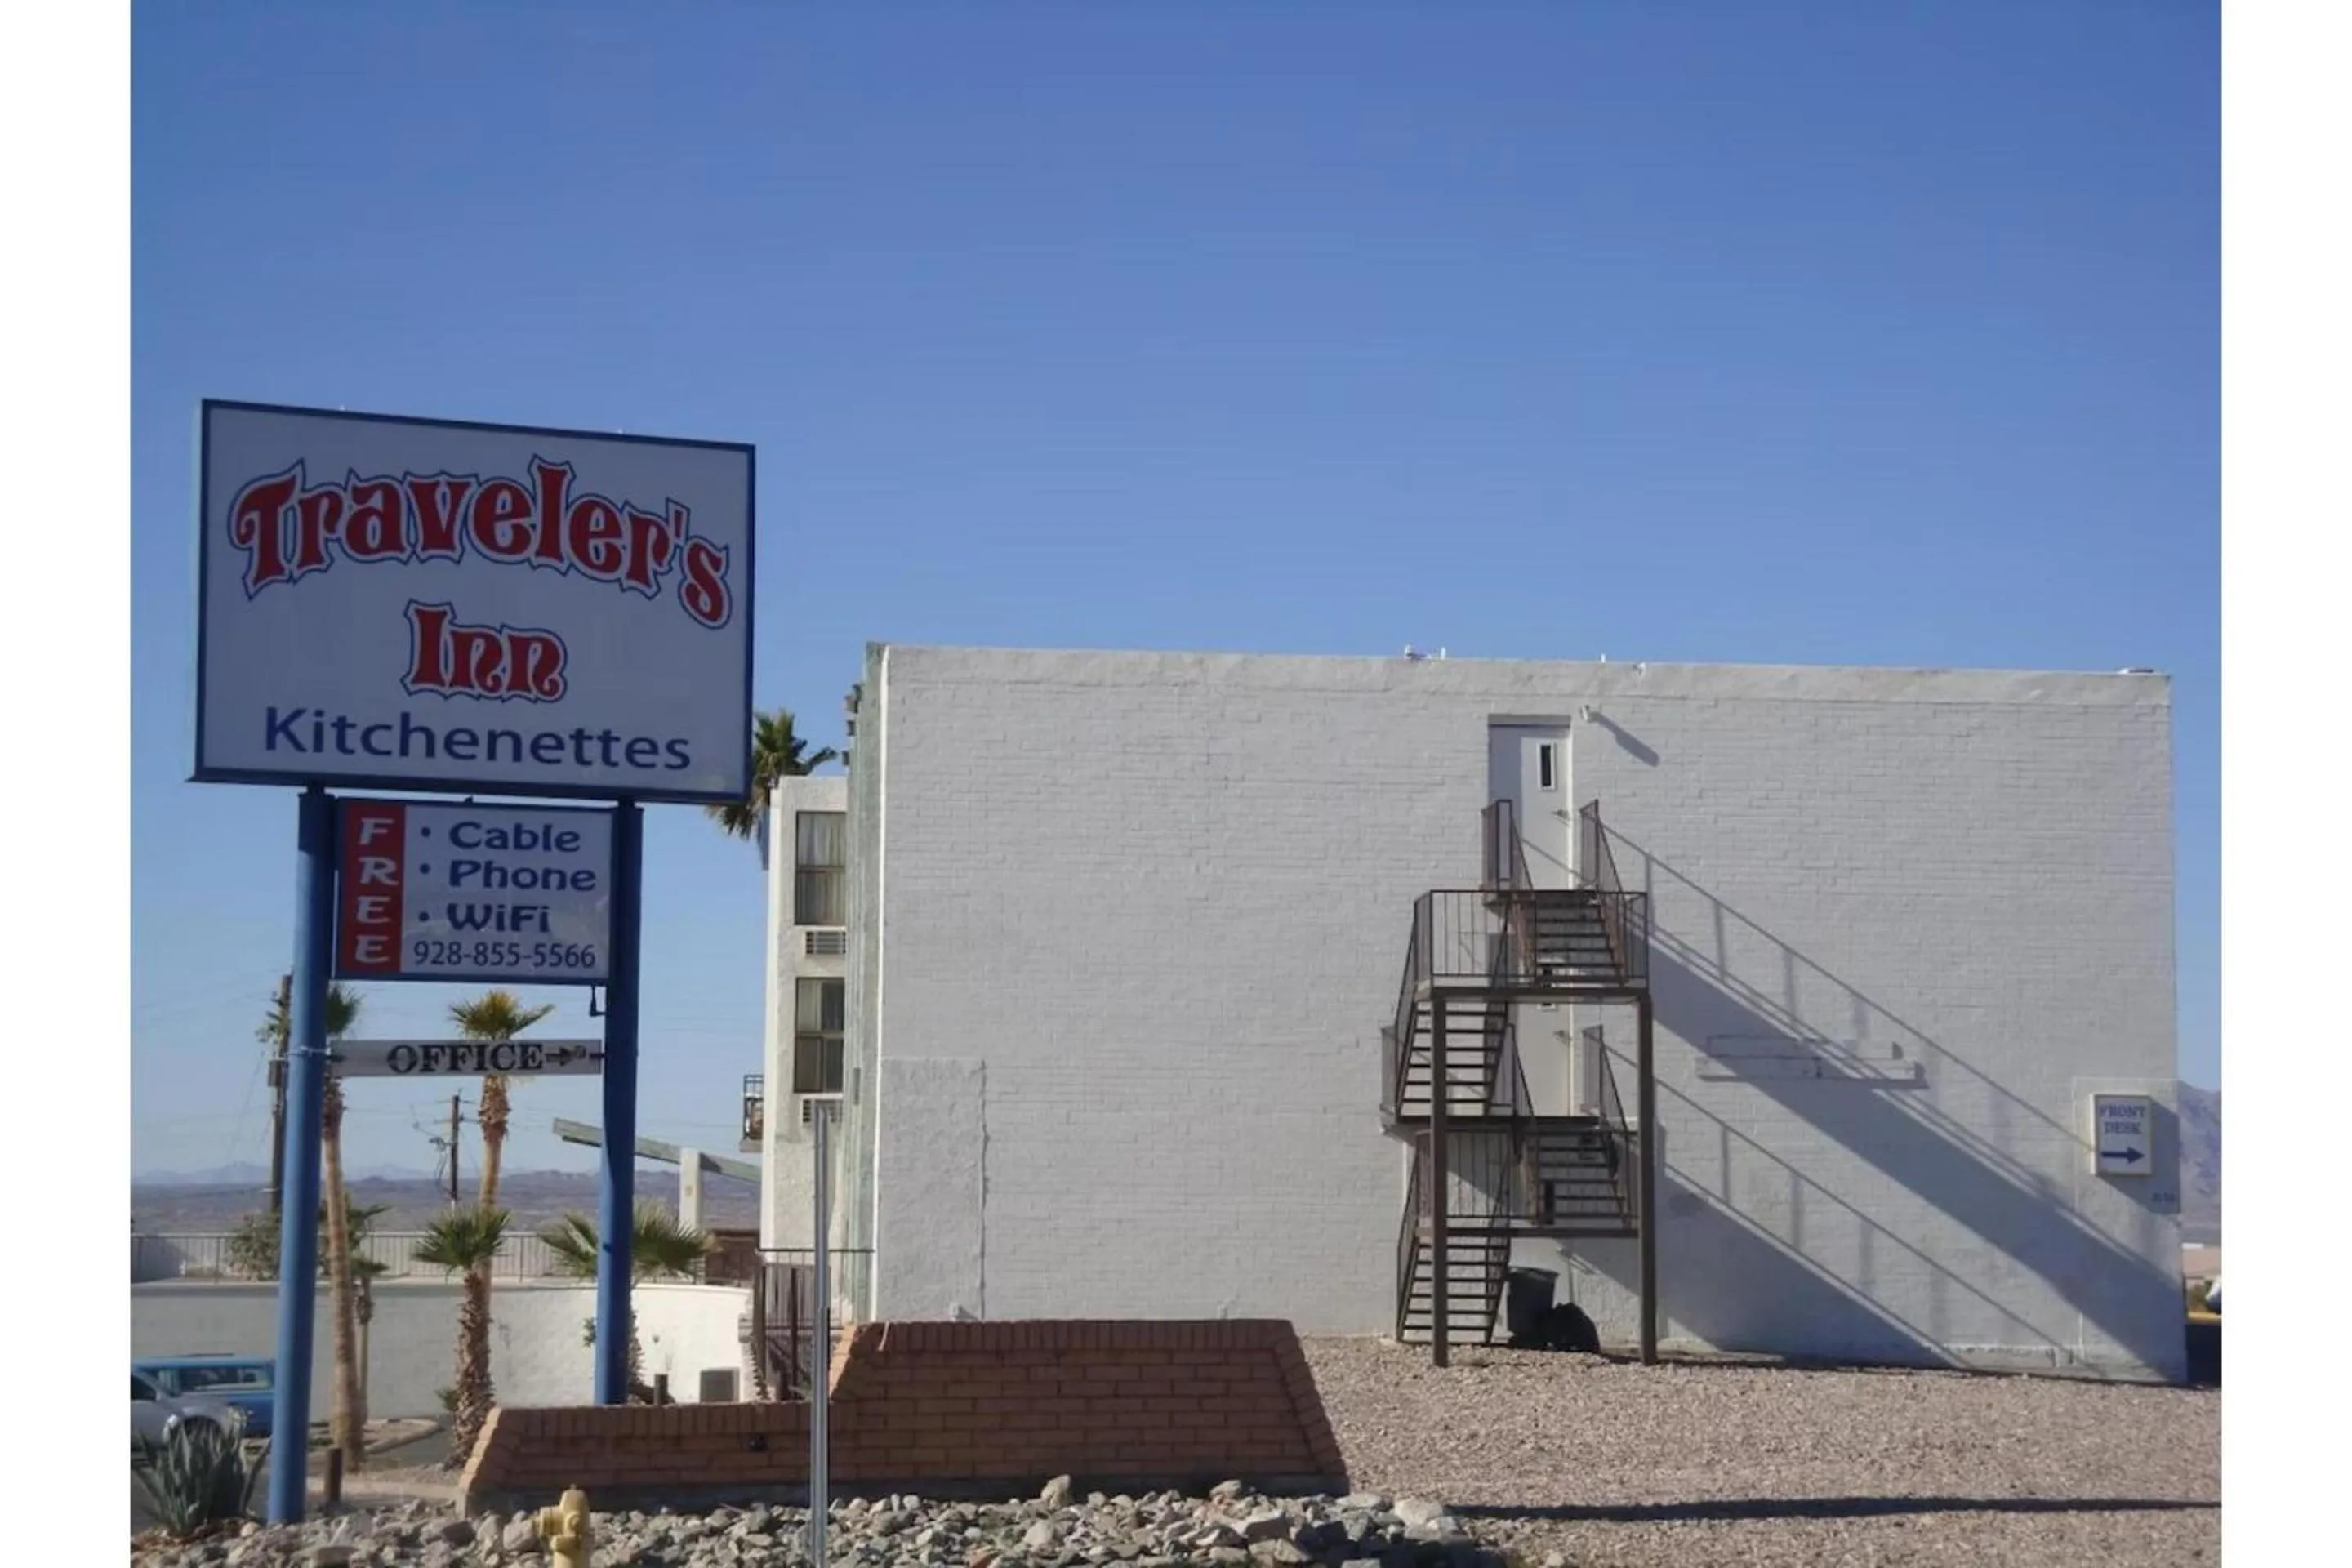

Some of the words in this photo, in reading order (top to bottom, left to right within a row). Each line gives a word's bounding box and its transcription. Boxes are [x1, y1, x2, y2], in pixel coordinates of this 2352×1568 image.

[229, 455, 731, 628] Traveler's
[402, 599, 567, 702] Inn
[264, 706, 692, 770] Kitchenettes
[448, 821, 581, 853] Cable
[354, 817, 399, 964] FREE
[448, 860, 596, 891] Phone
[447, 903, 550, 933] WiFi
[413, 941, 596, 969] 928-855-5566
[386, 1043, 543, 1075] OFFICE
[2099, 1104, 2146, 1118] FRONT
